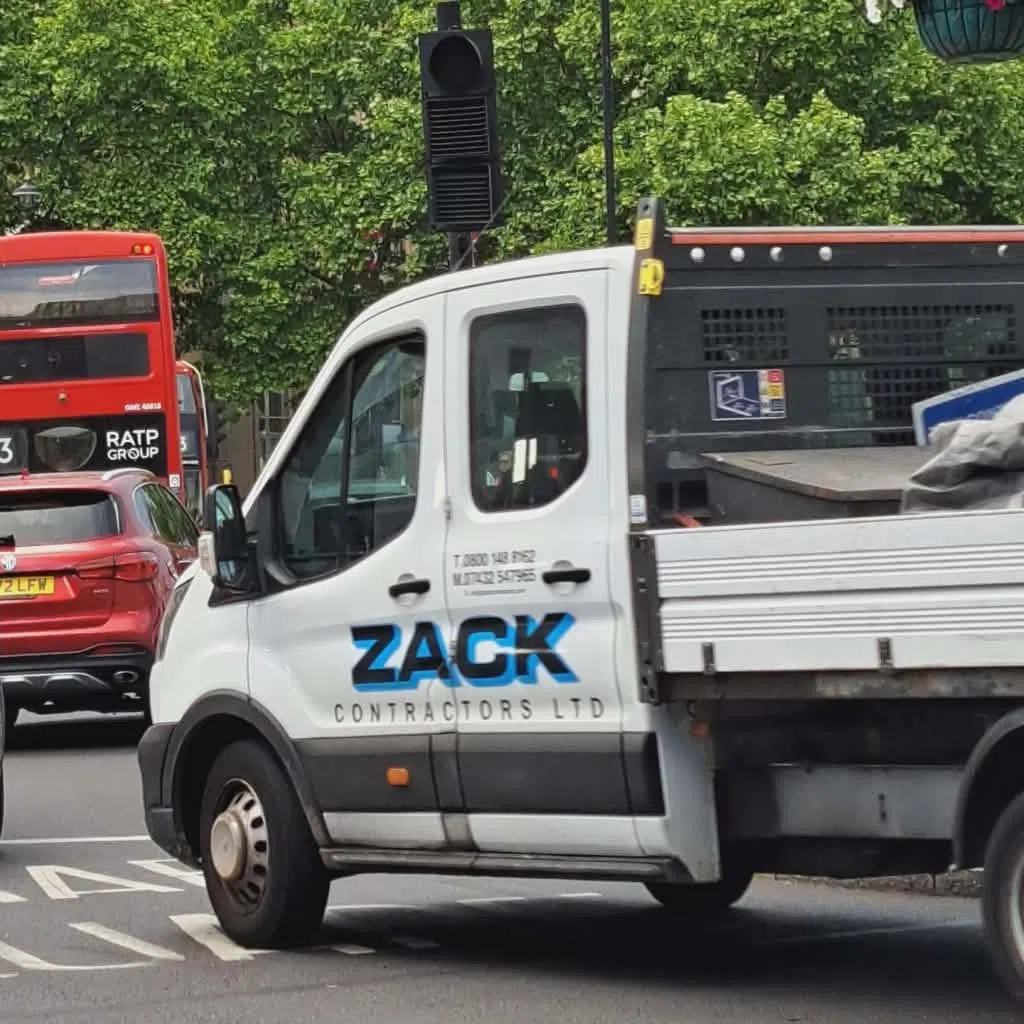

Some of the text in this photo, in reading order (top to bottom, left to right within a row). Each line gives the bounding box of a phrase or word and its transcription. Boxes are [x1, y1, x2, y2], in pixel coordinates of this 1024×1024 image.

[106, 429, 159, 447] RATP
[107, 447, 159, 461] GROUP
[17, 577, 48, 592] LFW
[350, 612, 581, 692] ZACK
[334, 697, 606, 723] CONTRACTORS LTD
